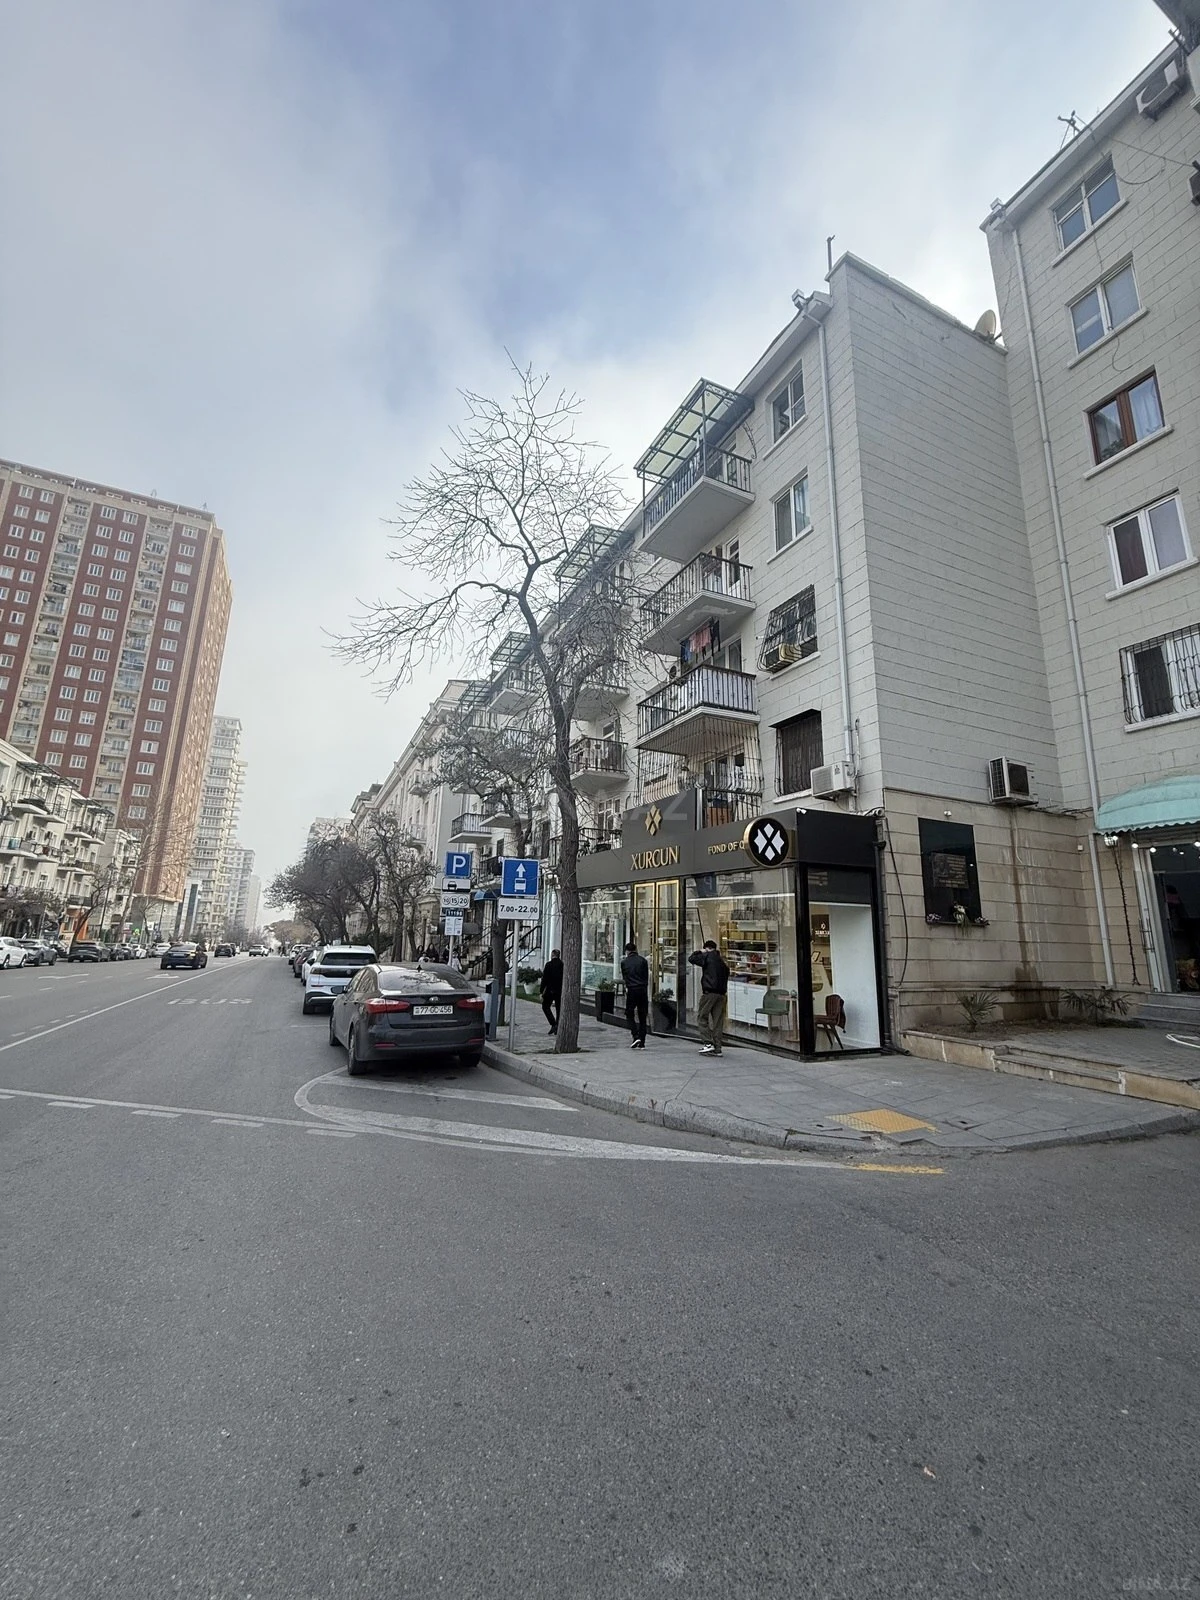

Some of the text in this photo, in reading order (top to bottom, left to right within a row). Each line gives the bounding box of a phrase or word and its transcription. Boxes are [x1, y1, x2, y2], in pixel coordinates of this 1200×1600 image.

[708, 843, 728, 855] FOND
[728, 841, 739, 851] OF
[452, 855, 466, 874] P
[630, 845, 680, 871] XURCUN
